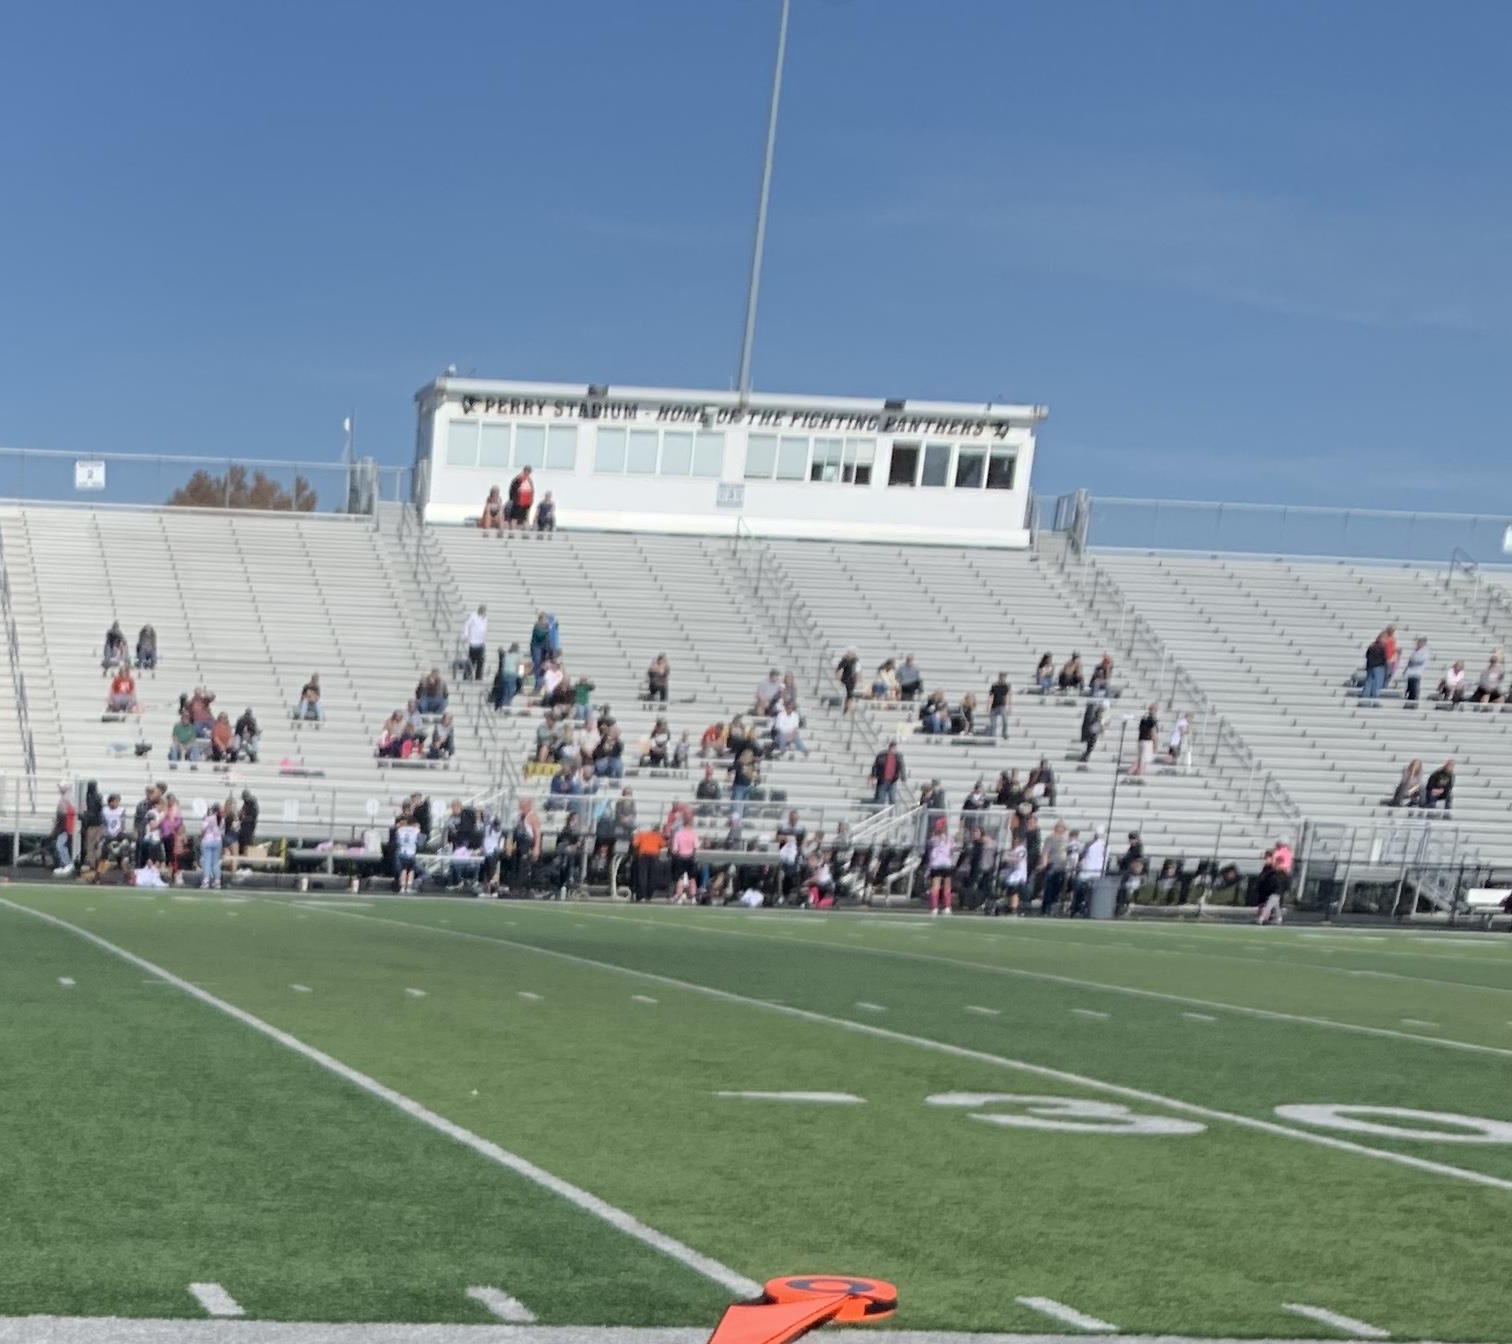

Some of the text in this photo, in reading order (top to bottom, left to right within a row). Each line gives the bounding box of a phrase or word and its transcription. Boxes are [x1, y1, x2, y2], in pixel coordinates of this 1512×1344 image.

[484, 396, 546, 417] PERRY
[553, 398, 639, 420] STADIUM
[656, 403, 711, 424] HOME
[747, 407, 785, 427] THE
[789, 409, 881, 432] FIGHTING
[883, 415, 986, 437] PANTHERS
